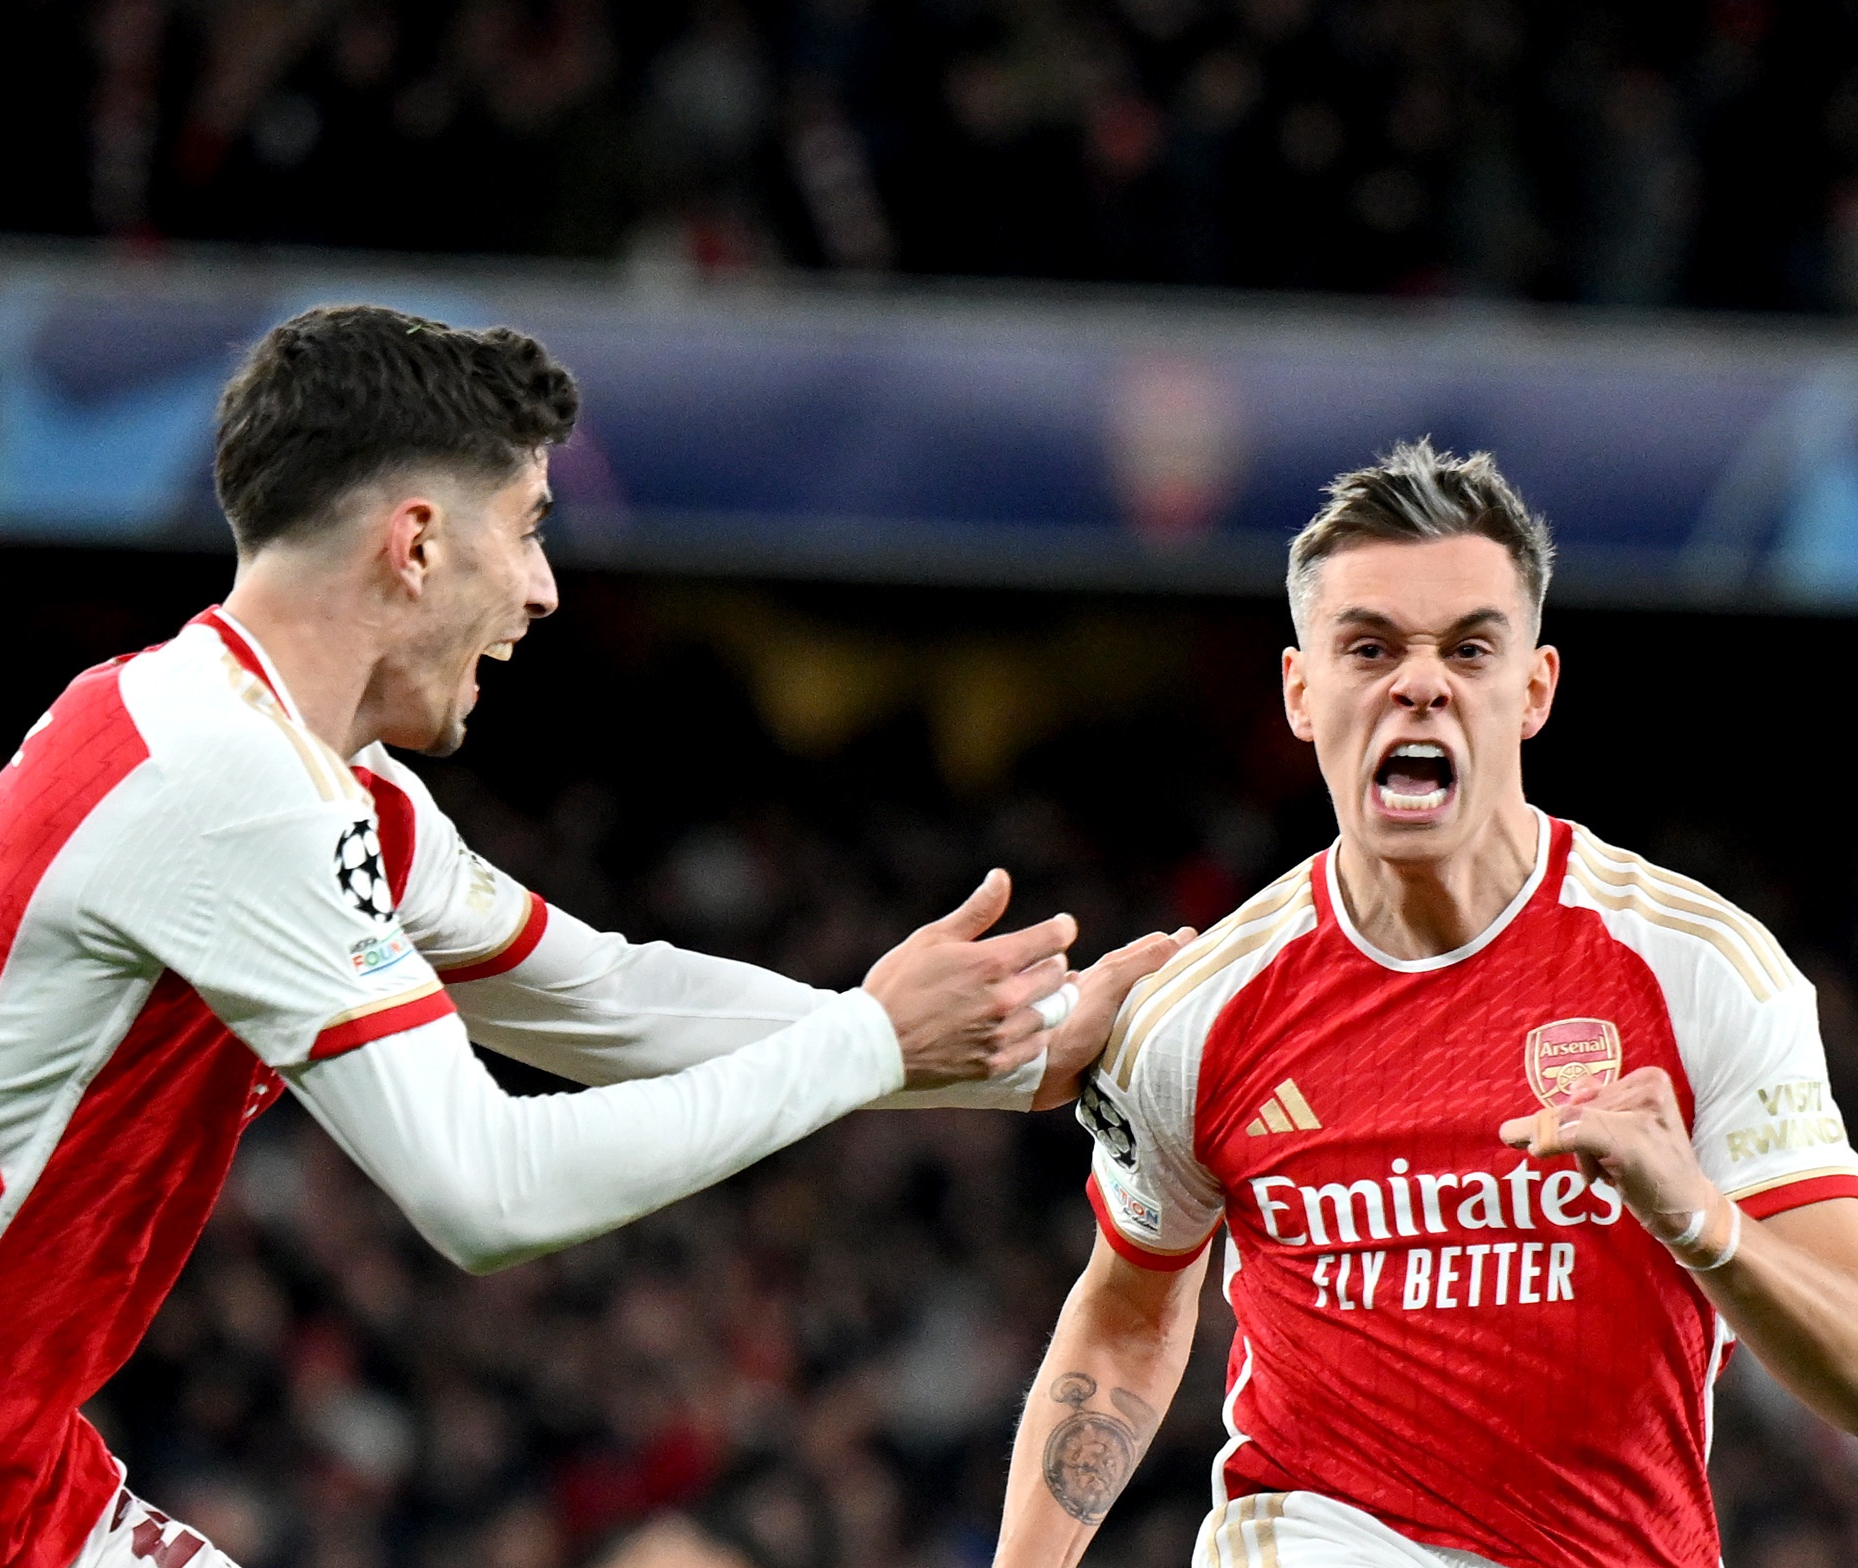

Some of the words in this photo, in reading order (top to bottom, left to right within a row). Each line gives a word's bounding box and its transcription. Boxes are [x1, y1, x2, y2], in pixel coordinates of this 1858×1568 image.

[1539, 1033, 1607, 1058] Arsenal
[1757, 1081, 1822, 1117] VISIT
[1248, 1157, 1624, 1247] Emirates
[1312, 1250, 1387, 1311] FLY
[1402, 1241, 1576, 1311] BETTER
